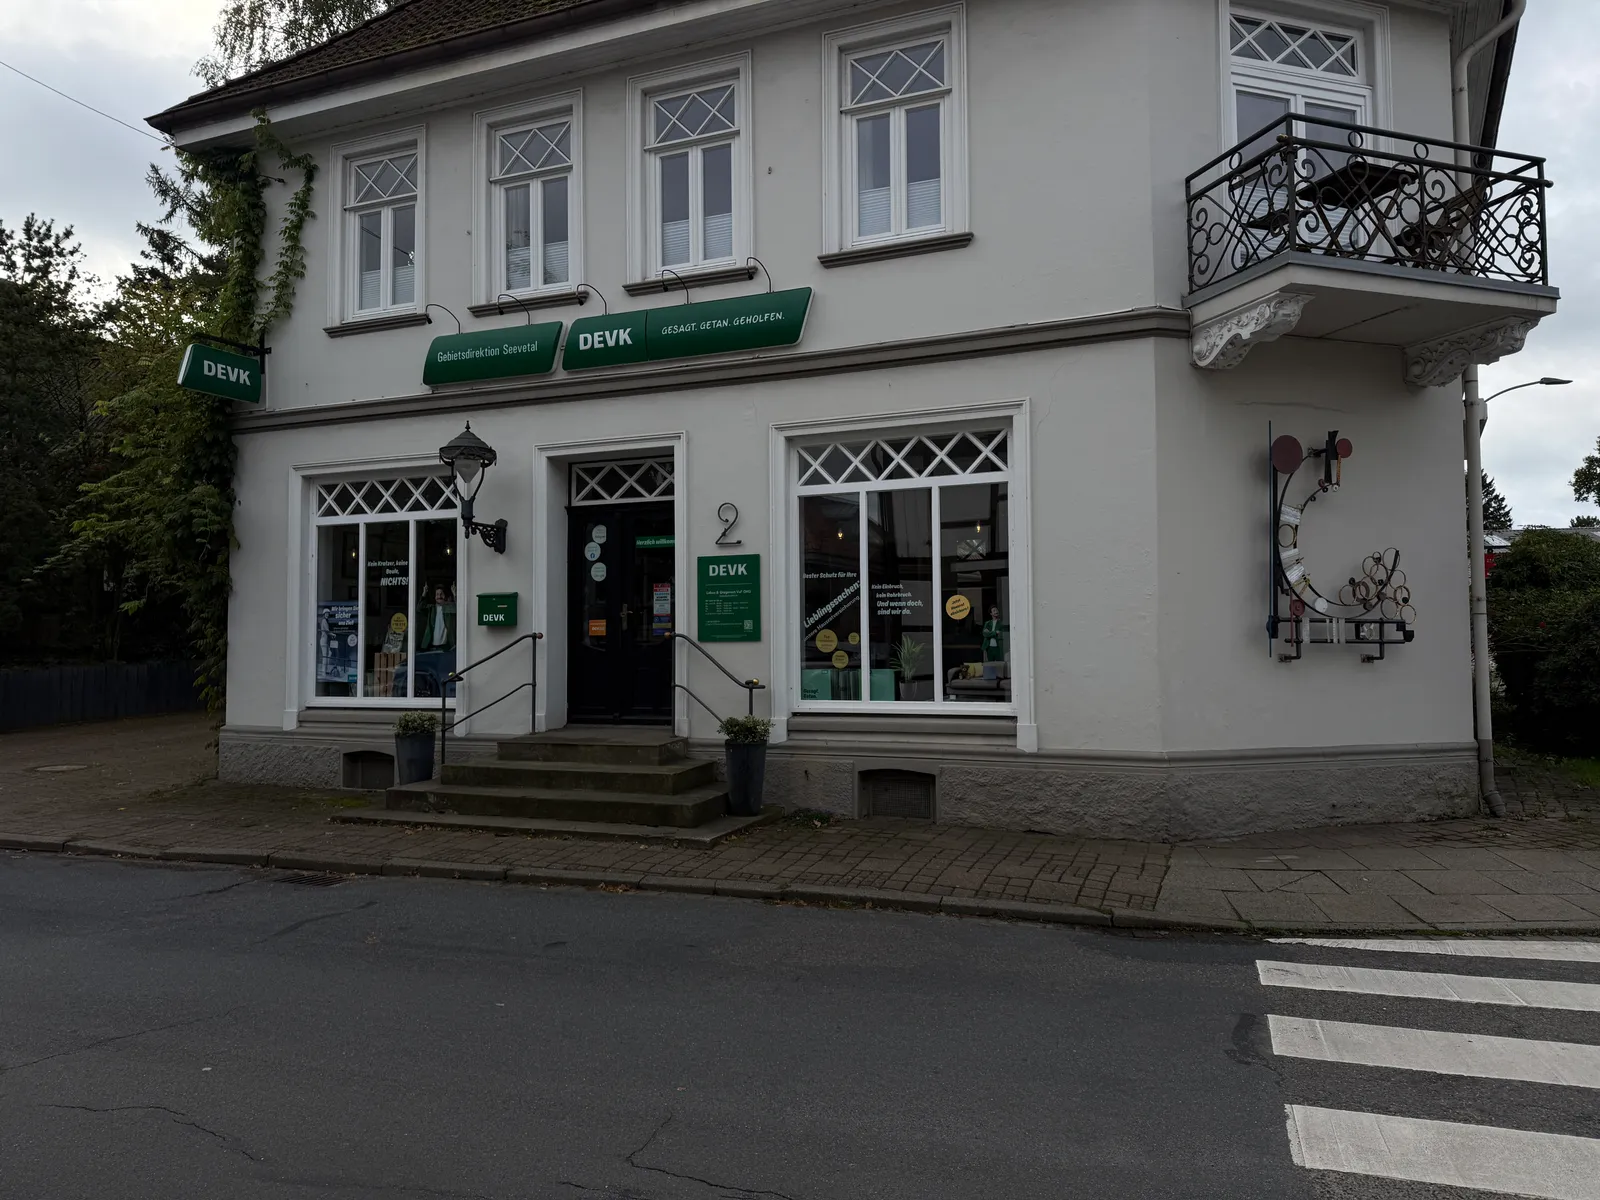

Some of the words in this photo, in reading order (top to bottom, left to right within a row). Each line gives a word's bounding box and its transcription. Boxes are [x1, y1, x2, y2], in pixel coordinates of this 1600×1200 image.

[579, 327, 633, 351] DEVK
[661, 322, 698, 335] GESAGT.
[700, 318, 732, 331] GETAN.
[733, 311, 785, 326] GEHOLFEN.
[437, 346, 500, 363] Gebietsdirektion
[502, 341, 538, 355] Seevetal
[203, 359, 251, 386] DEVK
[715, 502, 742, 545] 2
[635, 538, 655, 546] Herzlich
[708, 563, 748, 577] DEVK
[820, 571, 837, 579] Schutz
[380, 576, 409, 587] NICHTS!
[907, 599, 924, 607] doch,
[891, 607, 902, 615] wir
[483, 614, 505, 622] DEVK
